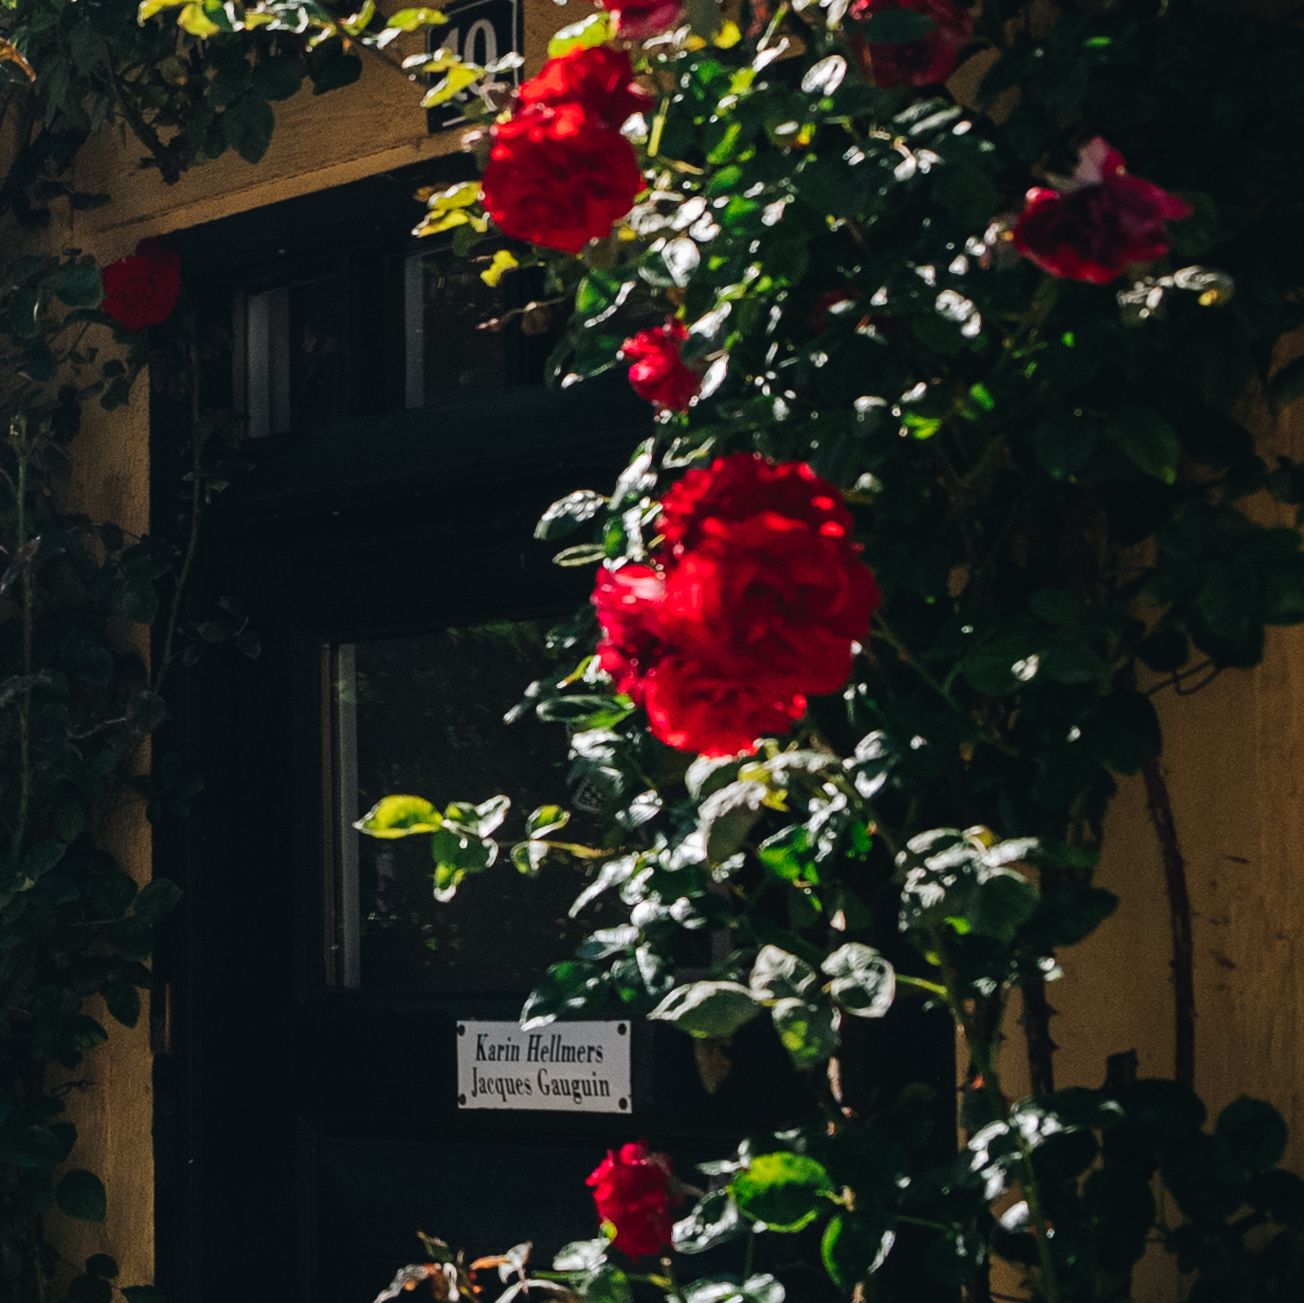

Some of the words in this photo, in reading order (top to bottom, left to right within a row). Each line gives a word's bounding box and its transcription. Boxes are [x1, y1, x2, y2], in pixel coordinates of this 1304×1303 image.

[475, 1034, 520, 1062] Karin
[526, 1034, 604, 1063] Hellmers
[471, 1066, 532, 1103] Jacques
[537, 1067, 610, 1104] Gauguin
